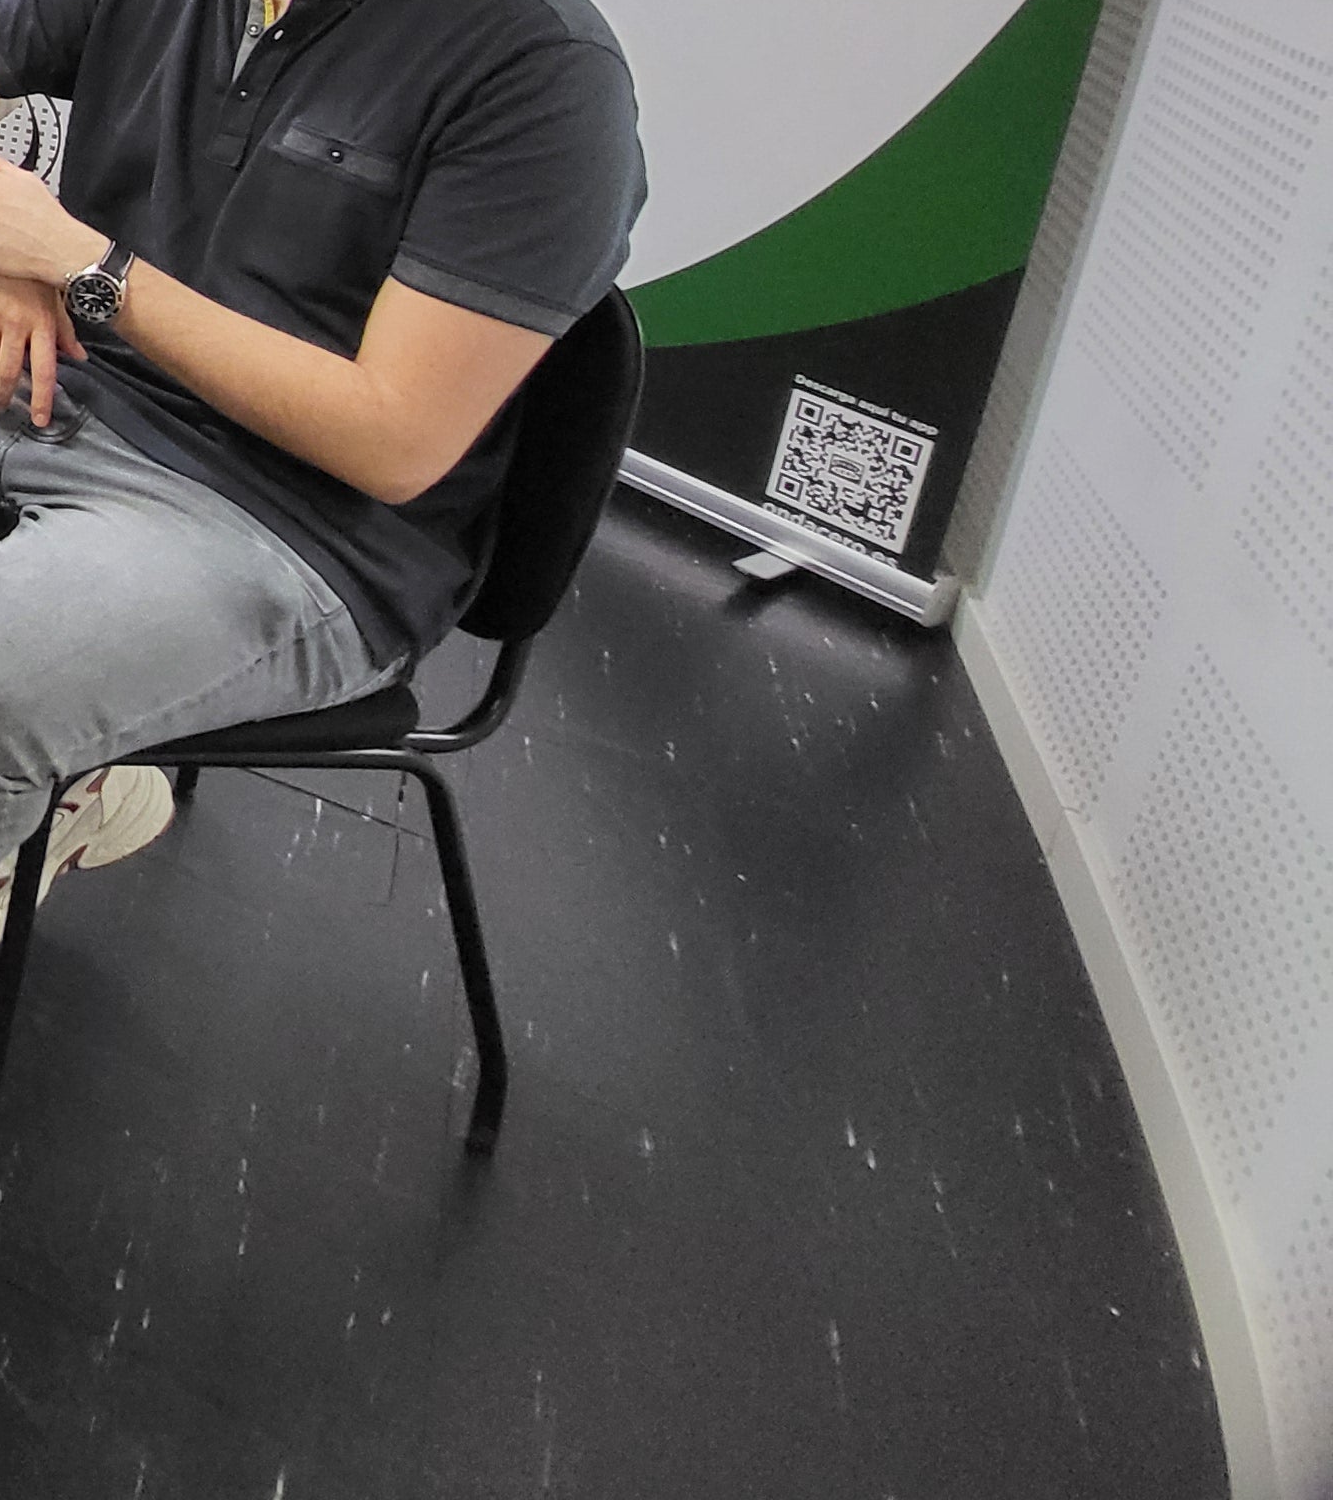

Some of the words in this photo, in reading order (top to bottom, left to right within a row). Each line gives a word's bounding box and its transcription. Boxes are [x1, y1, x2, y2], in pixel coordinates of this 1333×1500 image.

[794, 373, 857, 405] Descarga
[908, 419, 939, 436] app
[762, 502, 899, 569] ondaceroes
